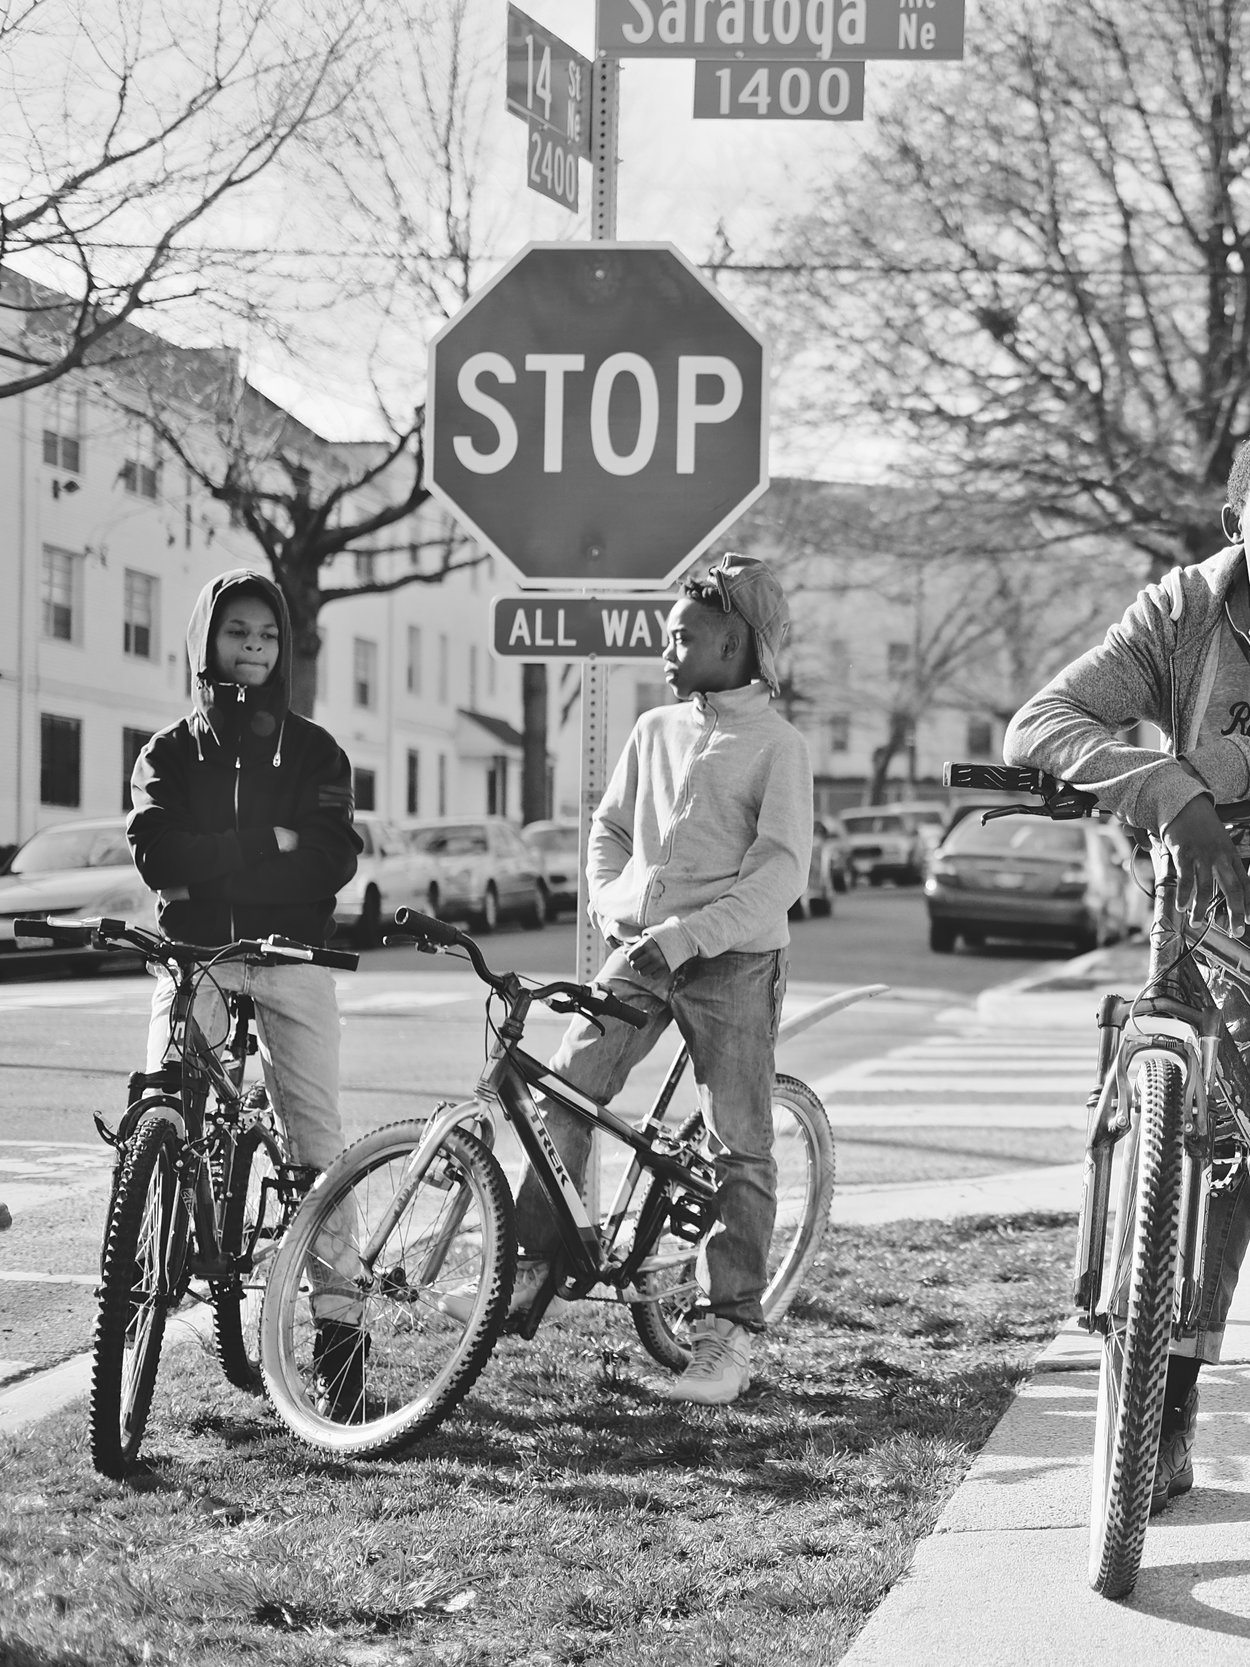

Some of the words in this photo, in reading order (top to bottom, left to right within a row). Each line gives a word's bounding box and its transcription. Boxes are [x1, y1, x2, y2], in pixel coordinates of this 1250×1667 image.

[622, 0, 867, 60] Saratoga
[899, 13, 936, 50] Ne
[525, 34, 552, 121] 14
[568, 60, 581, 101] St
[715, 66, 850, 115] 1400
[567, 100, 581, 142] Ne
[530, 131, 576, 203] 2400
[452, 352, 743, 476] STOP
[508, 608, 577, 646] ALL
[601, 608, 670, 647] WAY
[530, 1106, 569, 1187] TREK
